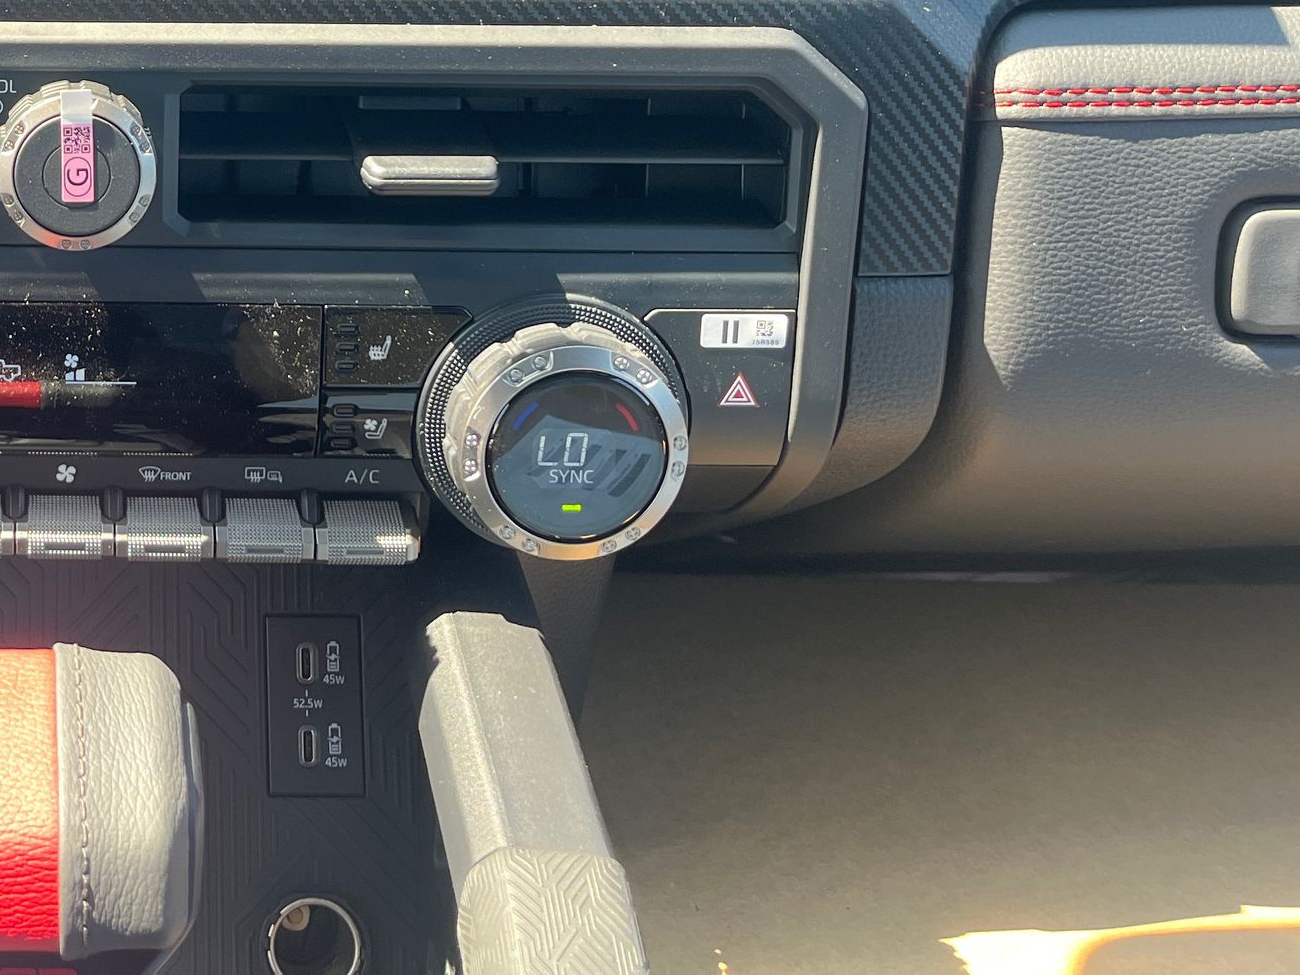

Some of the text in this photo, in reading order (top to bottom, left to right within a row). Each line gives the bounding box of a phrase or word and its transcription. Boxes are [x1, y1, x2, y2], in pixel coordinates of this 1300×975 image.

[538, 432, 588, 467] LO
[160, 471, 191, 481] FRONT
[345, 470, 380, 484] A/C
[548, 470, 594, 484] SYNC
[323, 675, 345, 684] 45W
[294, 698, 323, 708] 52.5W
[325, 757, 347, 767] 45W
